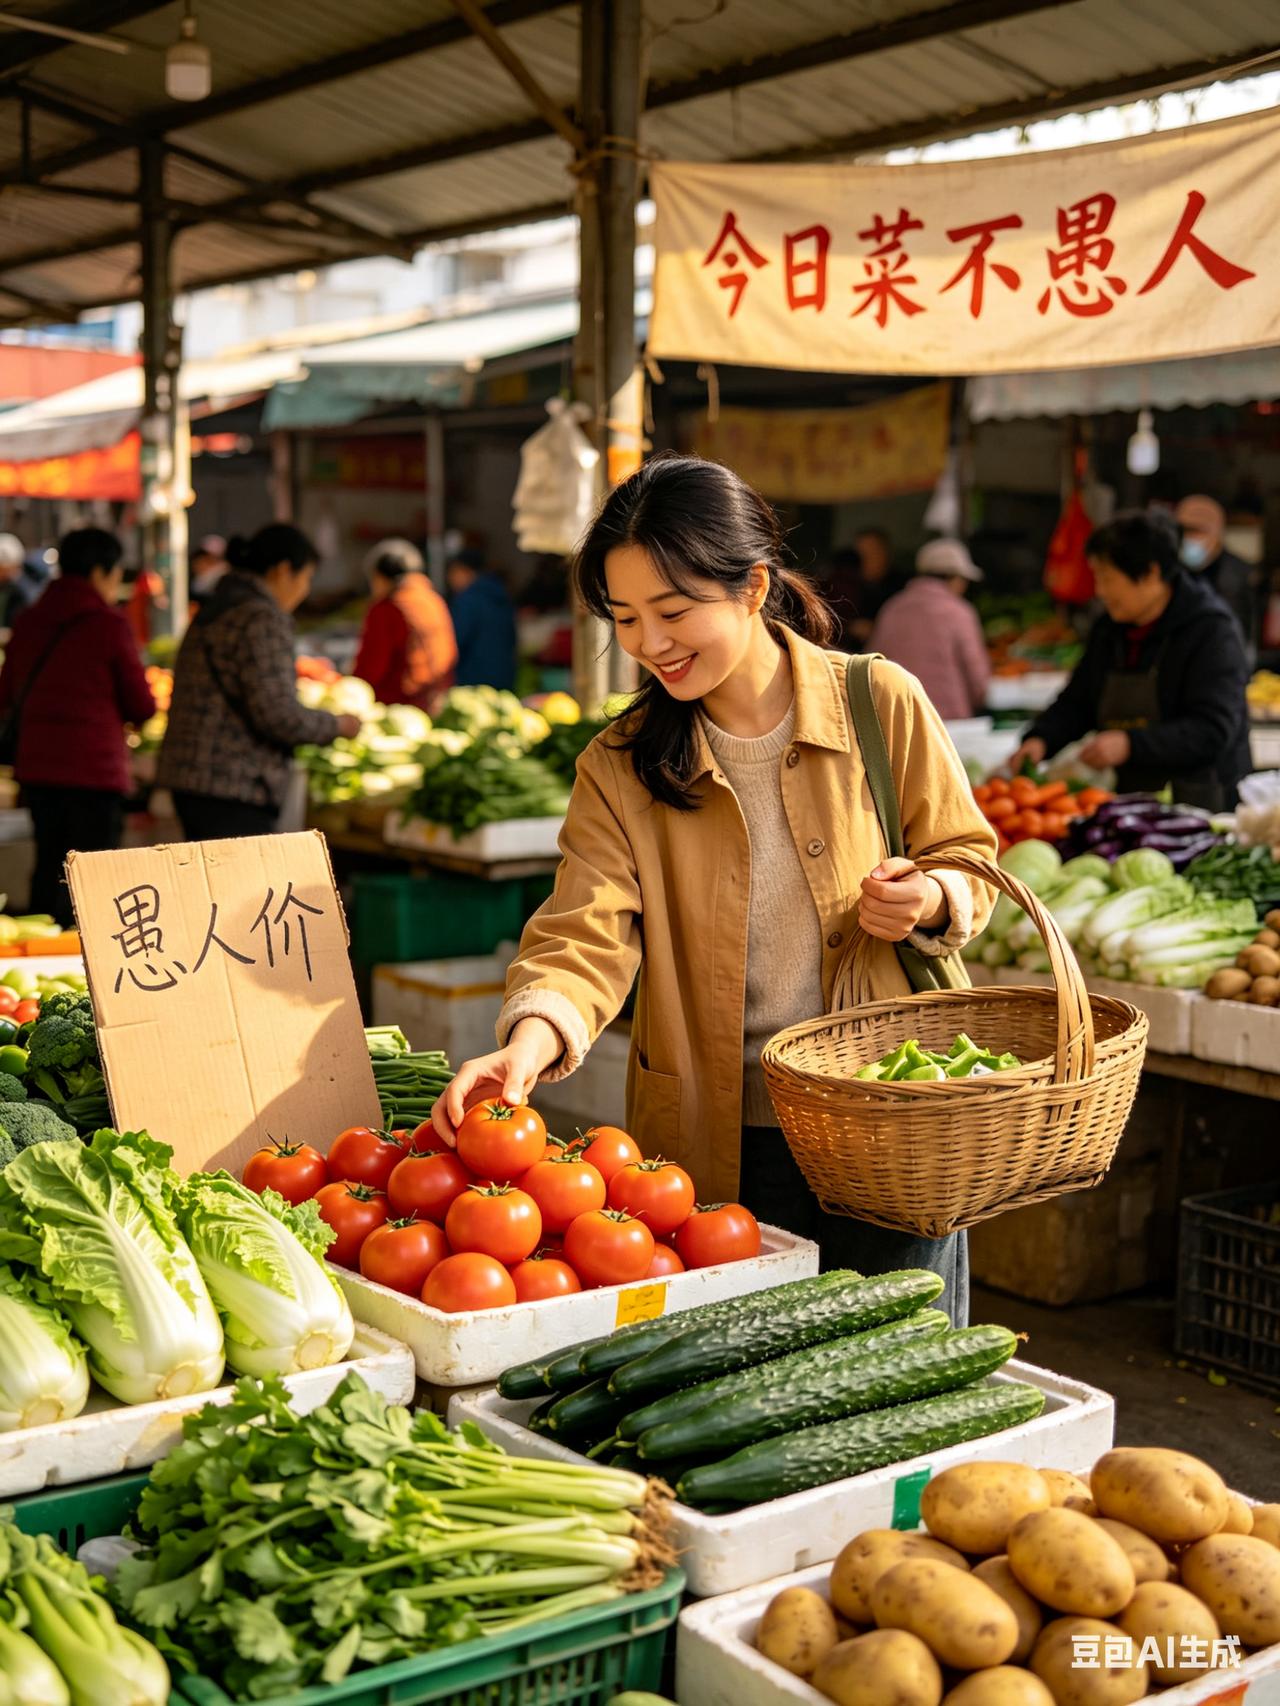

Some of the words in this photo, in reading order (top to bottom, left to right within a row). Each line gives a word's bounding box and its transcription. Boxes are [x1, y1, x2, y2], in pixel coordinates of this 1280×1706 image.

[701, 190, 1256, 330] 今日菜不愚人
[112, 881, 324, 994] 愚人价
